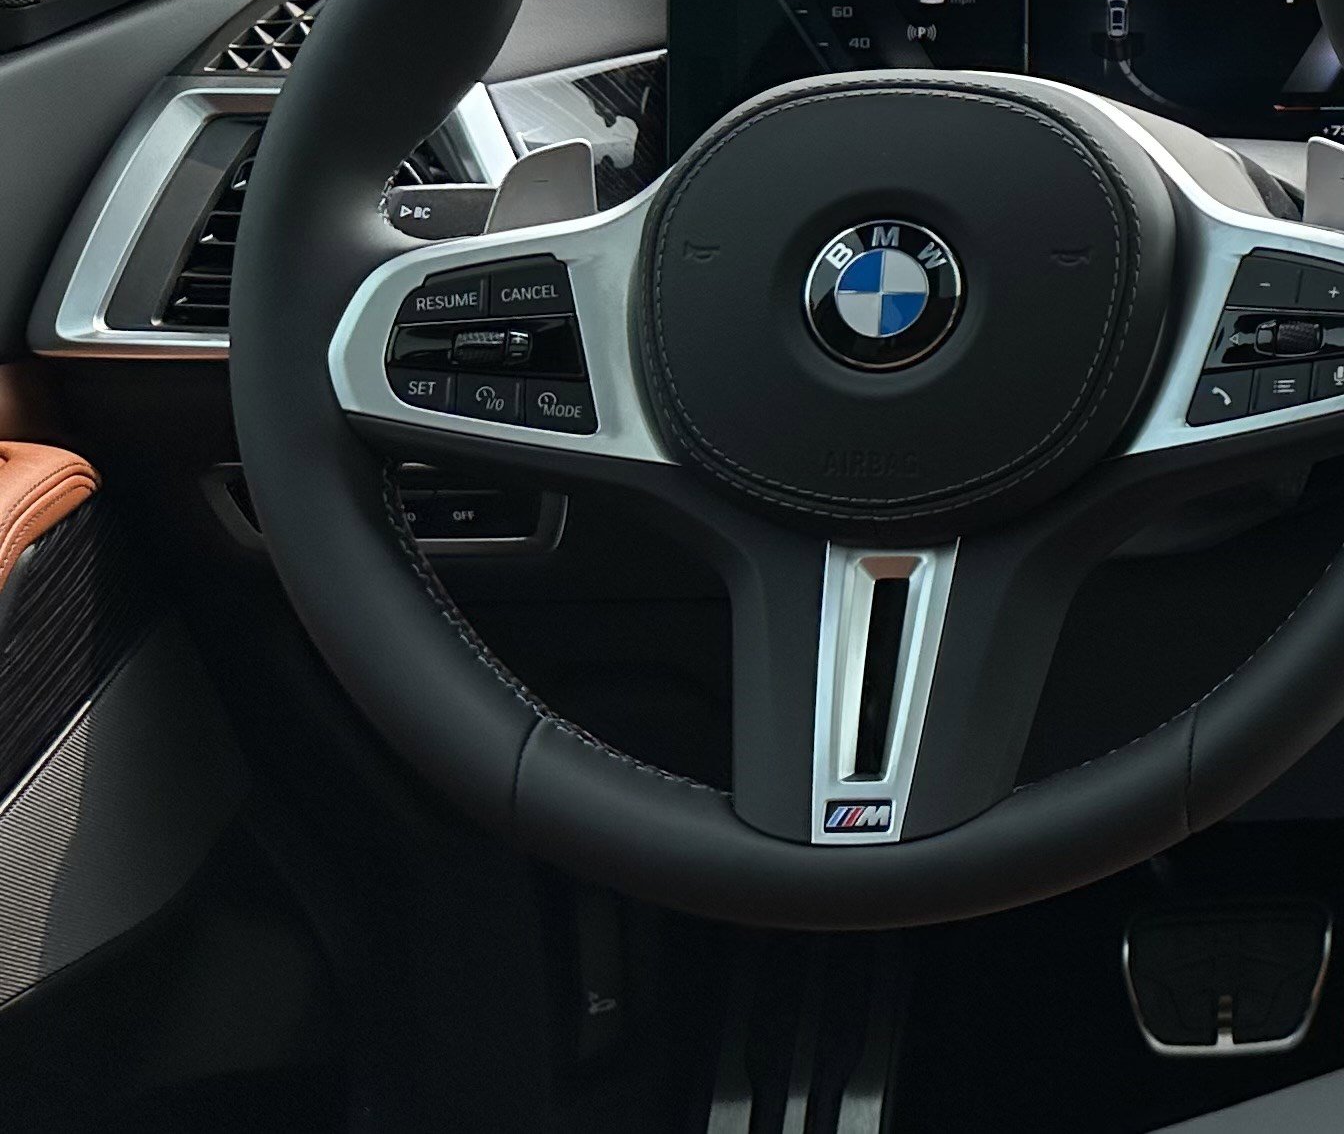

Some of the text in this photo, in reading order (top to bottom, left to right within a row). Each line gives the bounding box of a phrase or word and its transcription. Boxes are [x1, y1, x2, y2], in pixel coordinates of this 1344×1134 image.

[831, 6, 853, 18] 60
[849, 37, 870, 49] 40
[824, 225, 949, 271] BMW
[416, 284, 559, 311] RESUME CANCEL
[407, 381, 436, 396] SET
[543, 404, 583, 418] MODE
[452, 510, 475, 521] OFF
